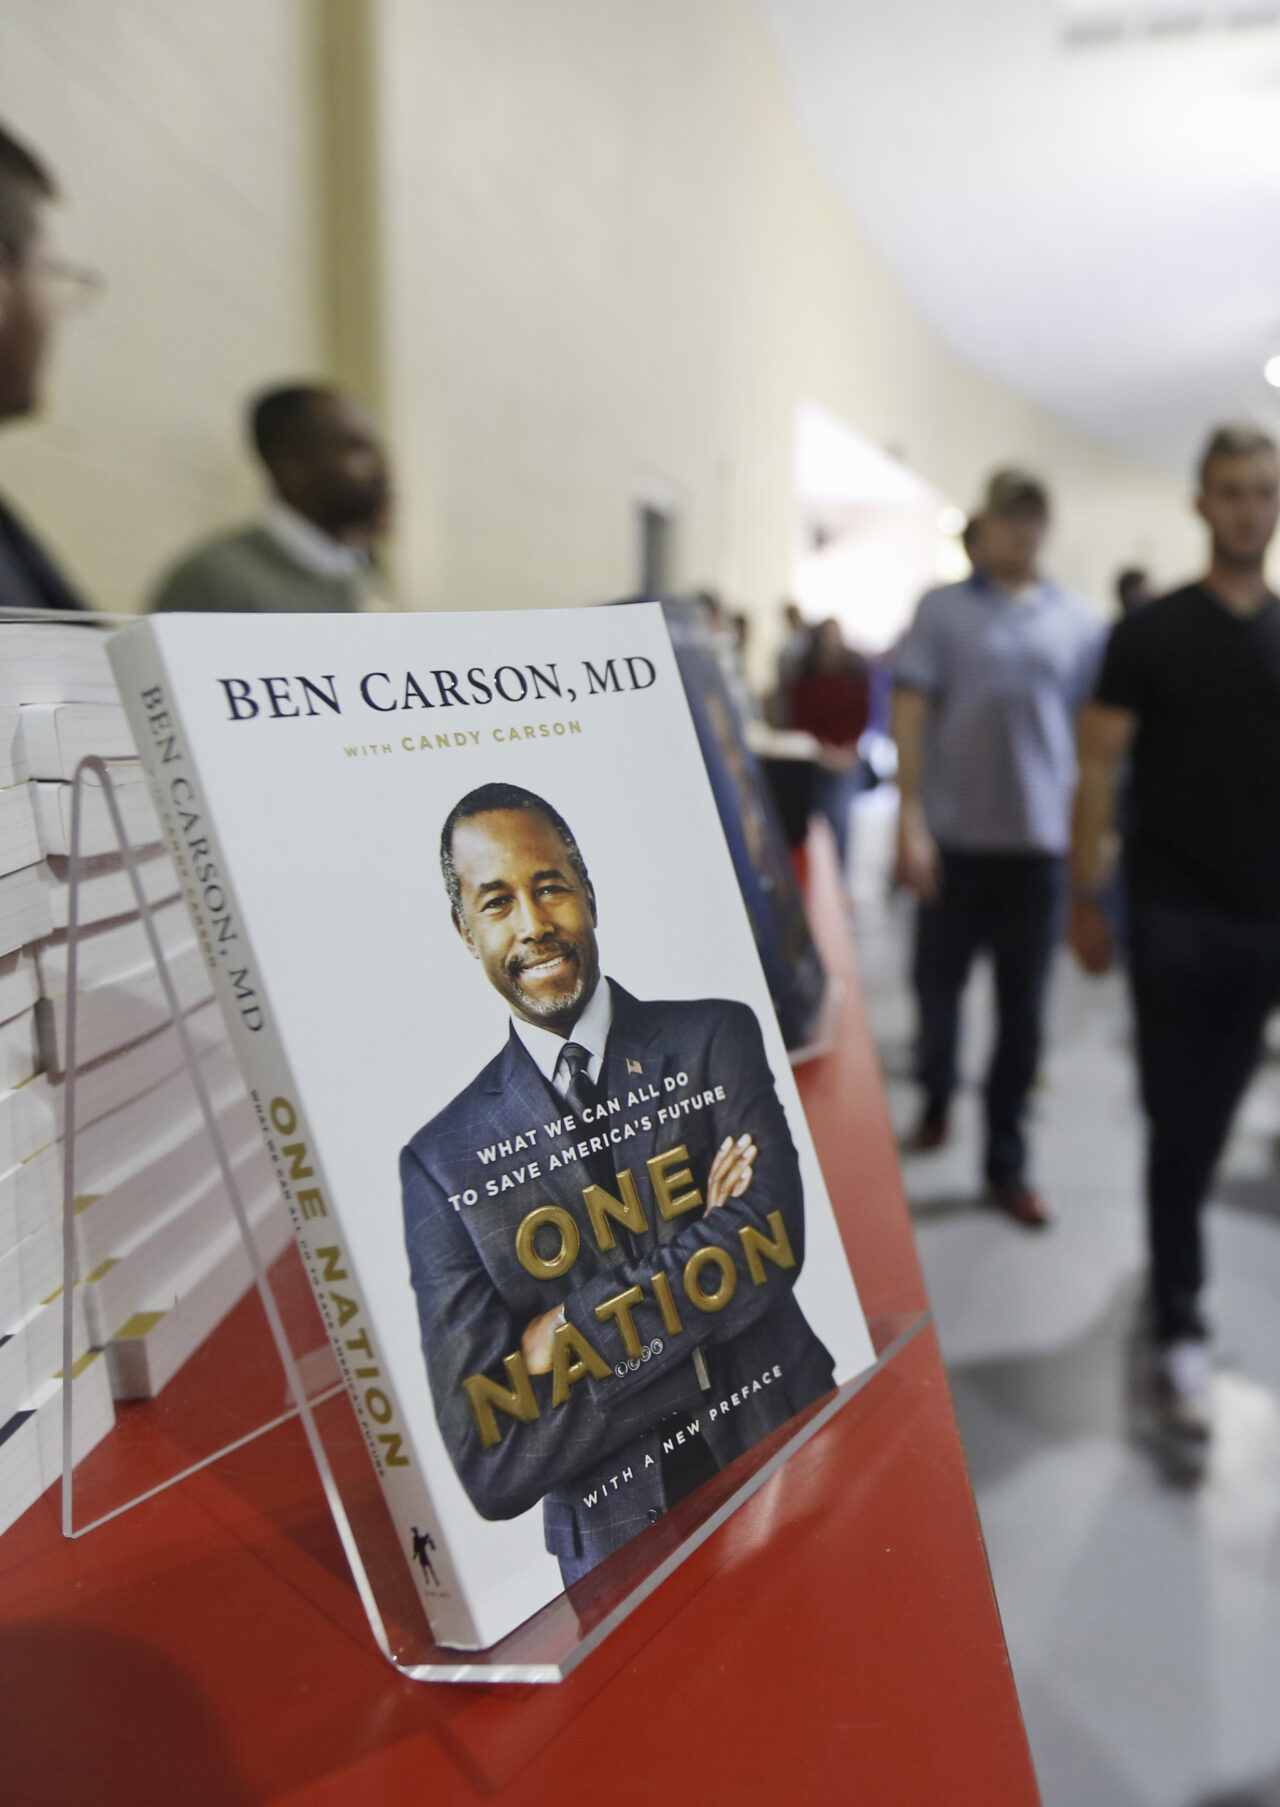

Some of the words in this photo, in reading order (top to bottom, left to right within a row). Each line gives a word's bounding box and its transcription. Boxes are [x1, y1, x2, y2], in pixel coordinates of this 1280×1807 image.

[216, 673, 343, 721] BEN
[360, 664, 577, 712] CARSON,
[581, 655, 657, 695] MD
[343, 743, 393, 758] WITH
[401, 730, 482, 753] CANDY
[492, 719, 583, 743] CARSON
[140, 685, 183, 764] BEN
[170, 777, 238, 956] CARSON,
[228, 968, 264, 1032] MD
[187, 887, 218, 968] CARSON
[447, 1187, 479, 1212] TO
[484, 1161, 542, 1197] SAVE
[548, 1115, 653, 1172] AMERICA'S
[657, 1084, 727, 1125] FUTURE
[476, 1130, 537, 1166] WHAT
[543, 1114, 577, 1139] WE
[582, 1097, 622, 1124] CAN
[626, 1083, 660, 1108] ALL
[663, 1071, 690, 1092] DO
[515, 1144, 704, 1281] ONE
[268, 1095, 328, 1222] ONE
[315, 1245, 410, 1467] NATION
[462, 1210, 797, 1450] NATION
[583, 1466, 635, 1509] WITH
[643, 1453, 655, 1468] A
[662, 1419, 701, 1454] NEW
[708, 1364, 783, 1422] PREFACE
